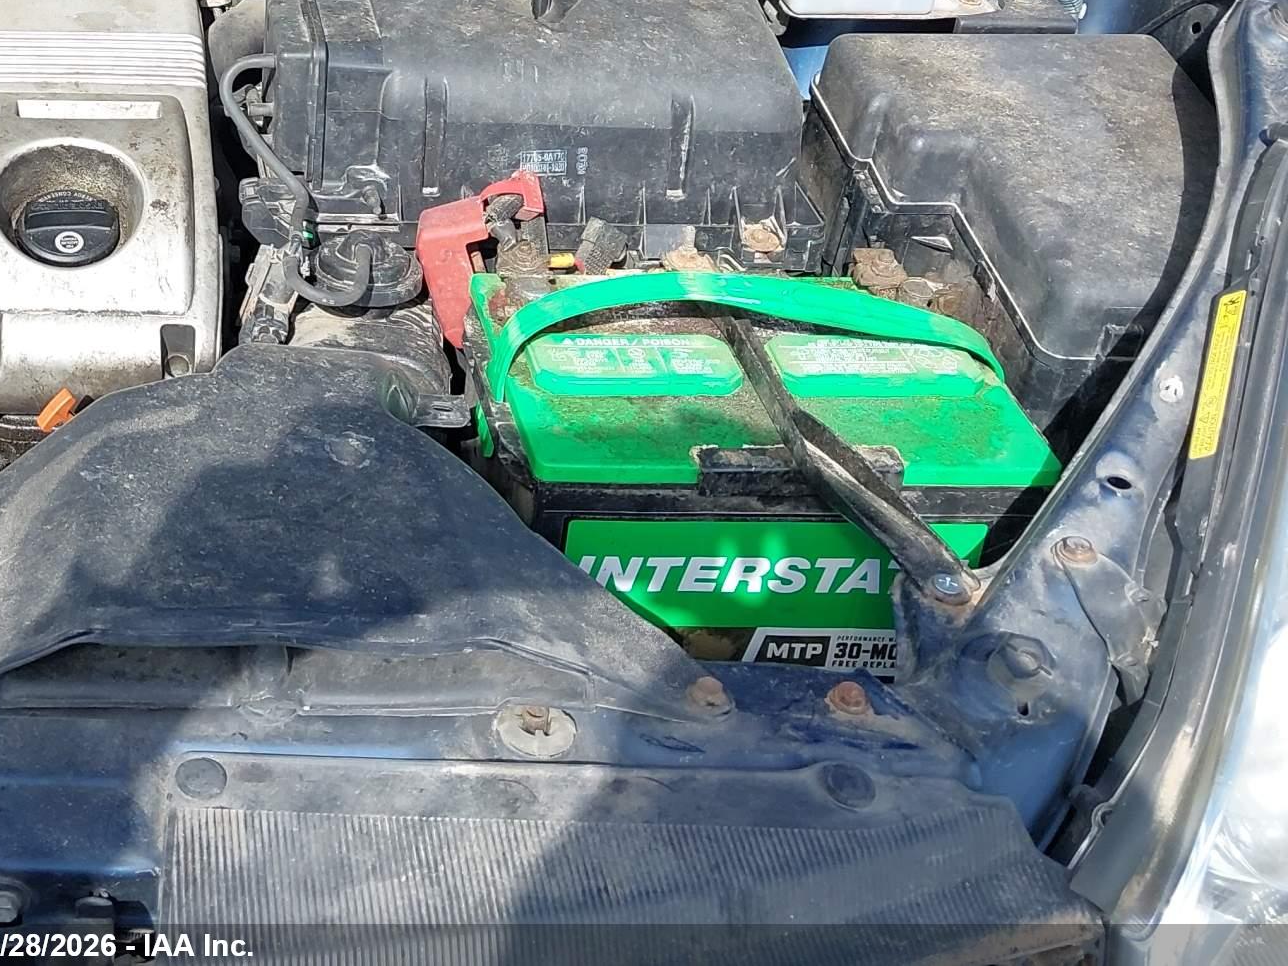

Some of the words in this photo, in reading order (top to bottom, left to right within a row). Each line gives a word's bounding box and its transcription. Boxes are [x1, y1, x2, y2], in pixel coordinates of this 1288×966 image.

[576, 337, 629, 346] DANGER
[642, 337, 691, 346] POISON
[578, 556, 902, 594] INTERSTA
[836, 635, 886, 643] PERFORMANCE
[766, 642, 823, 659] MTP
[831, 660, 858, 668] FREE
